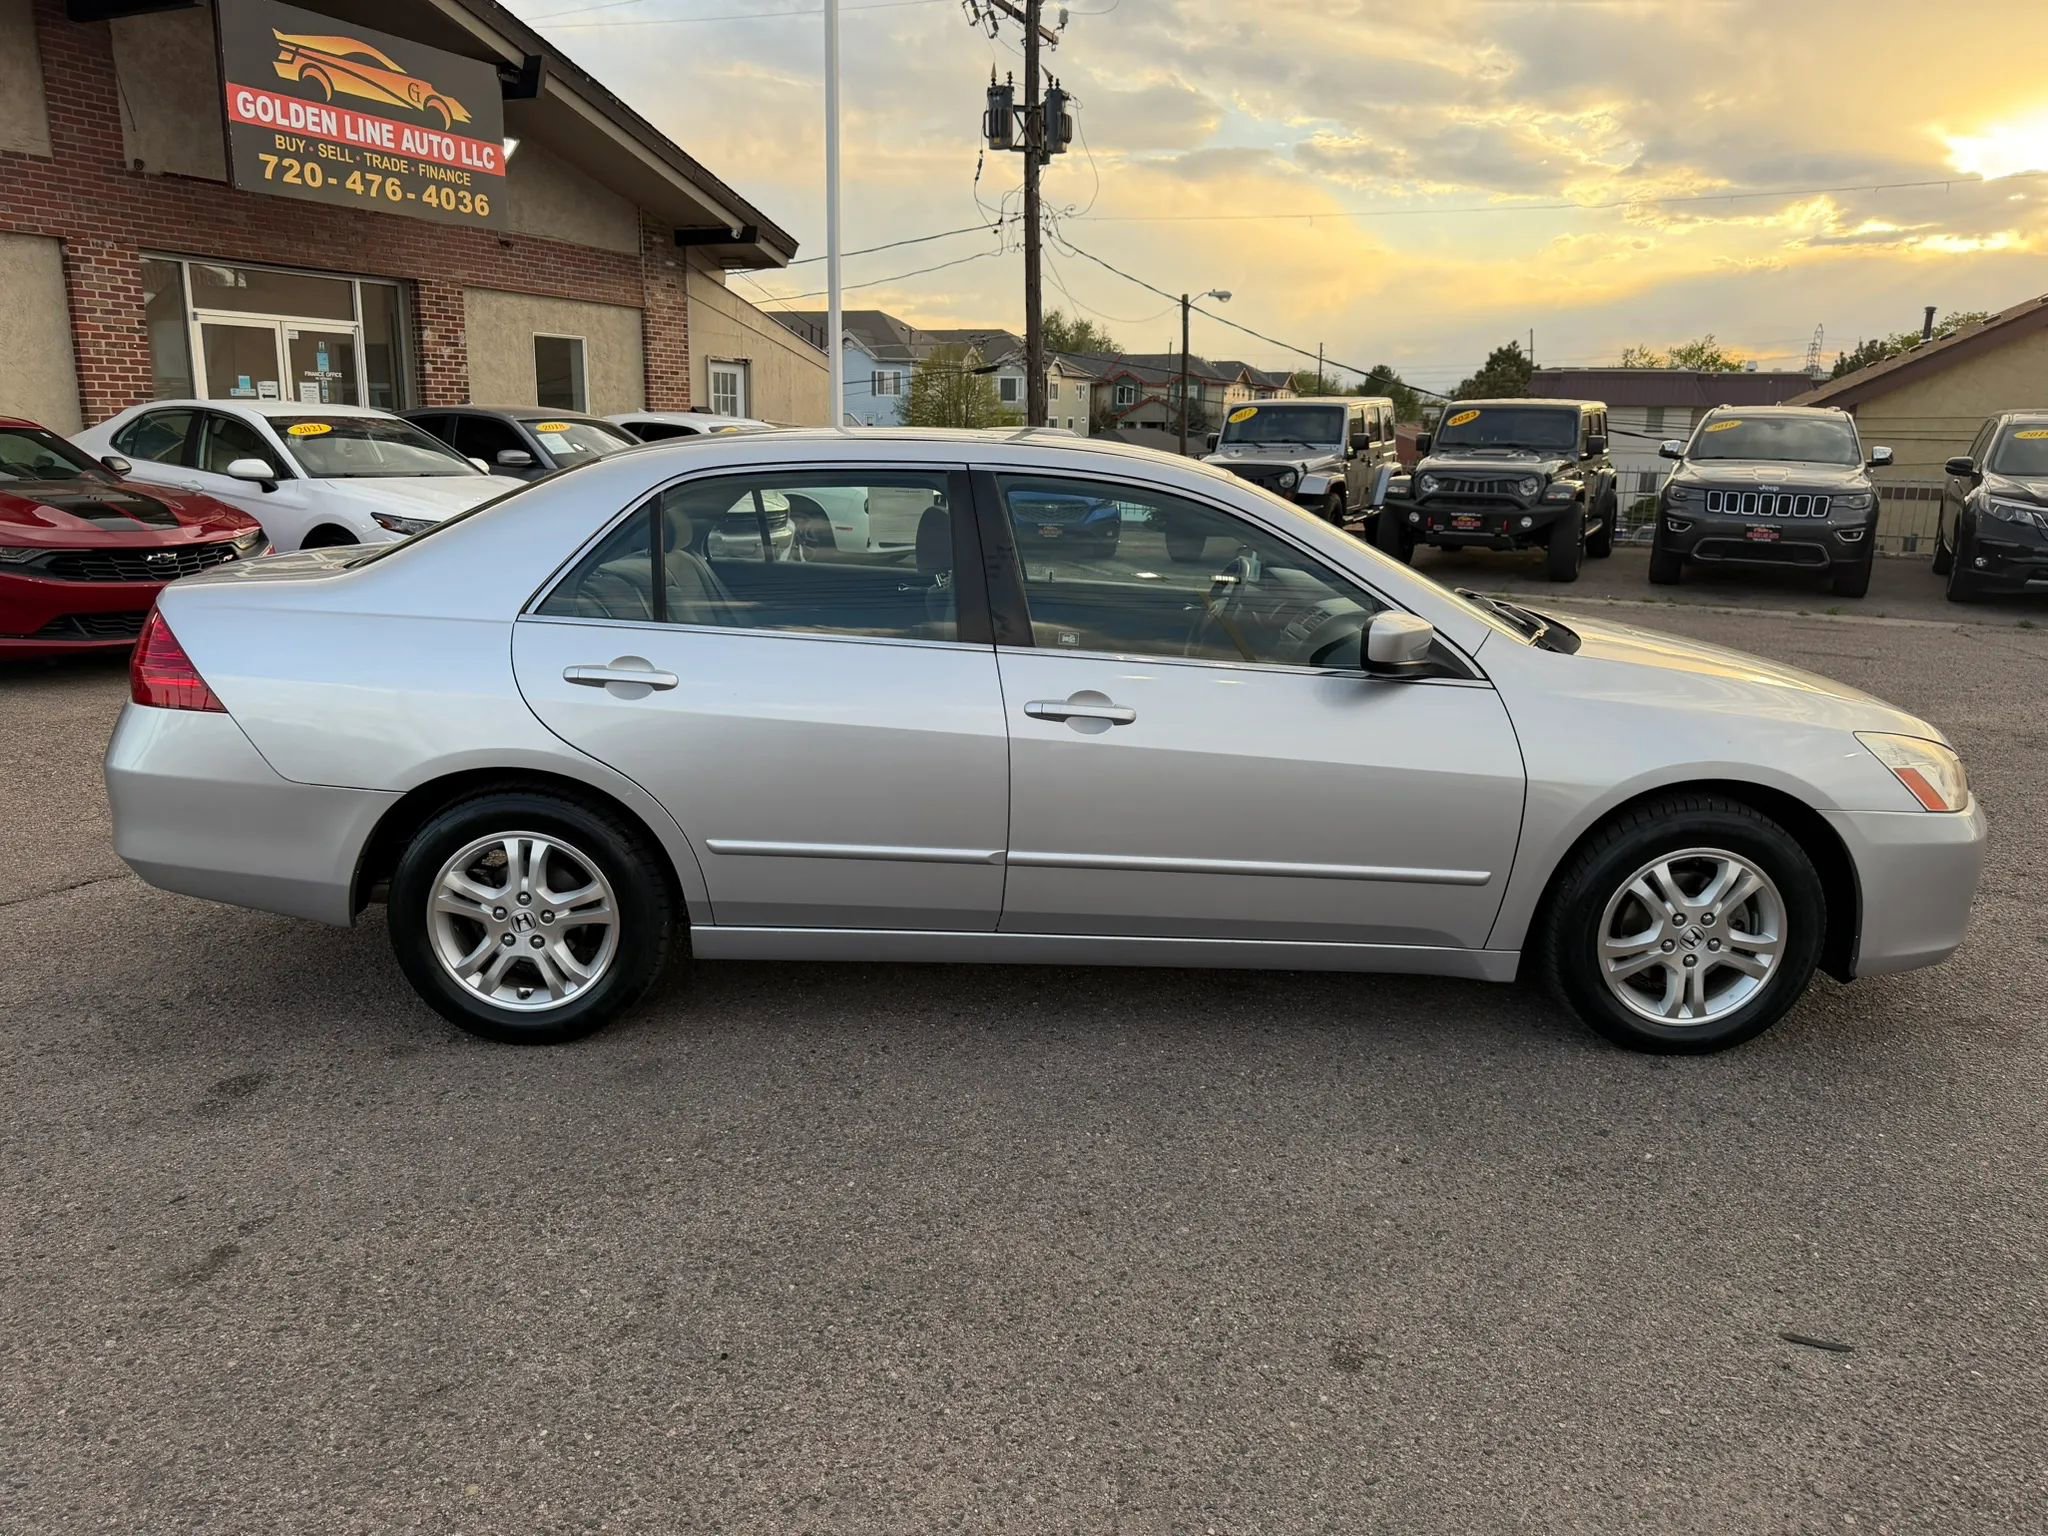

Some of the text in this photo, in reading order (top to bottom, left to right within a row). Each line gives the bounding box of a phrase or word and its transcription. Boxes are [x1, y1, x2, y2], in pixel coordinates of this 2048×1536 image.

[236, 91, 496, 170] GOLDEN LINE AUTO LLC
[274, 134, 472, 187] BUY SELL TRADE FINANCE
[304, 370, 325, 378] FINANCE
[1450, 410, 1478, 425] 2023
[298, 424, 323, 434] 2021
[1758, 484, 1780, 492] Jeep
